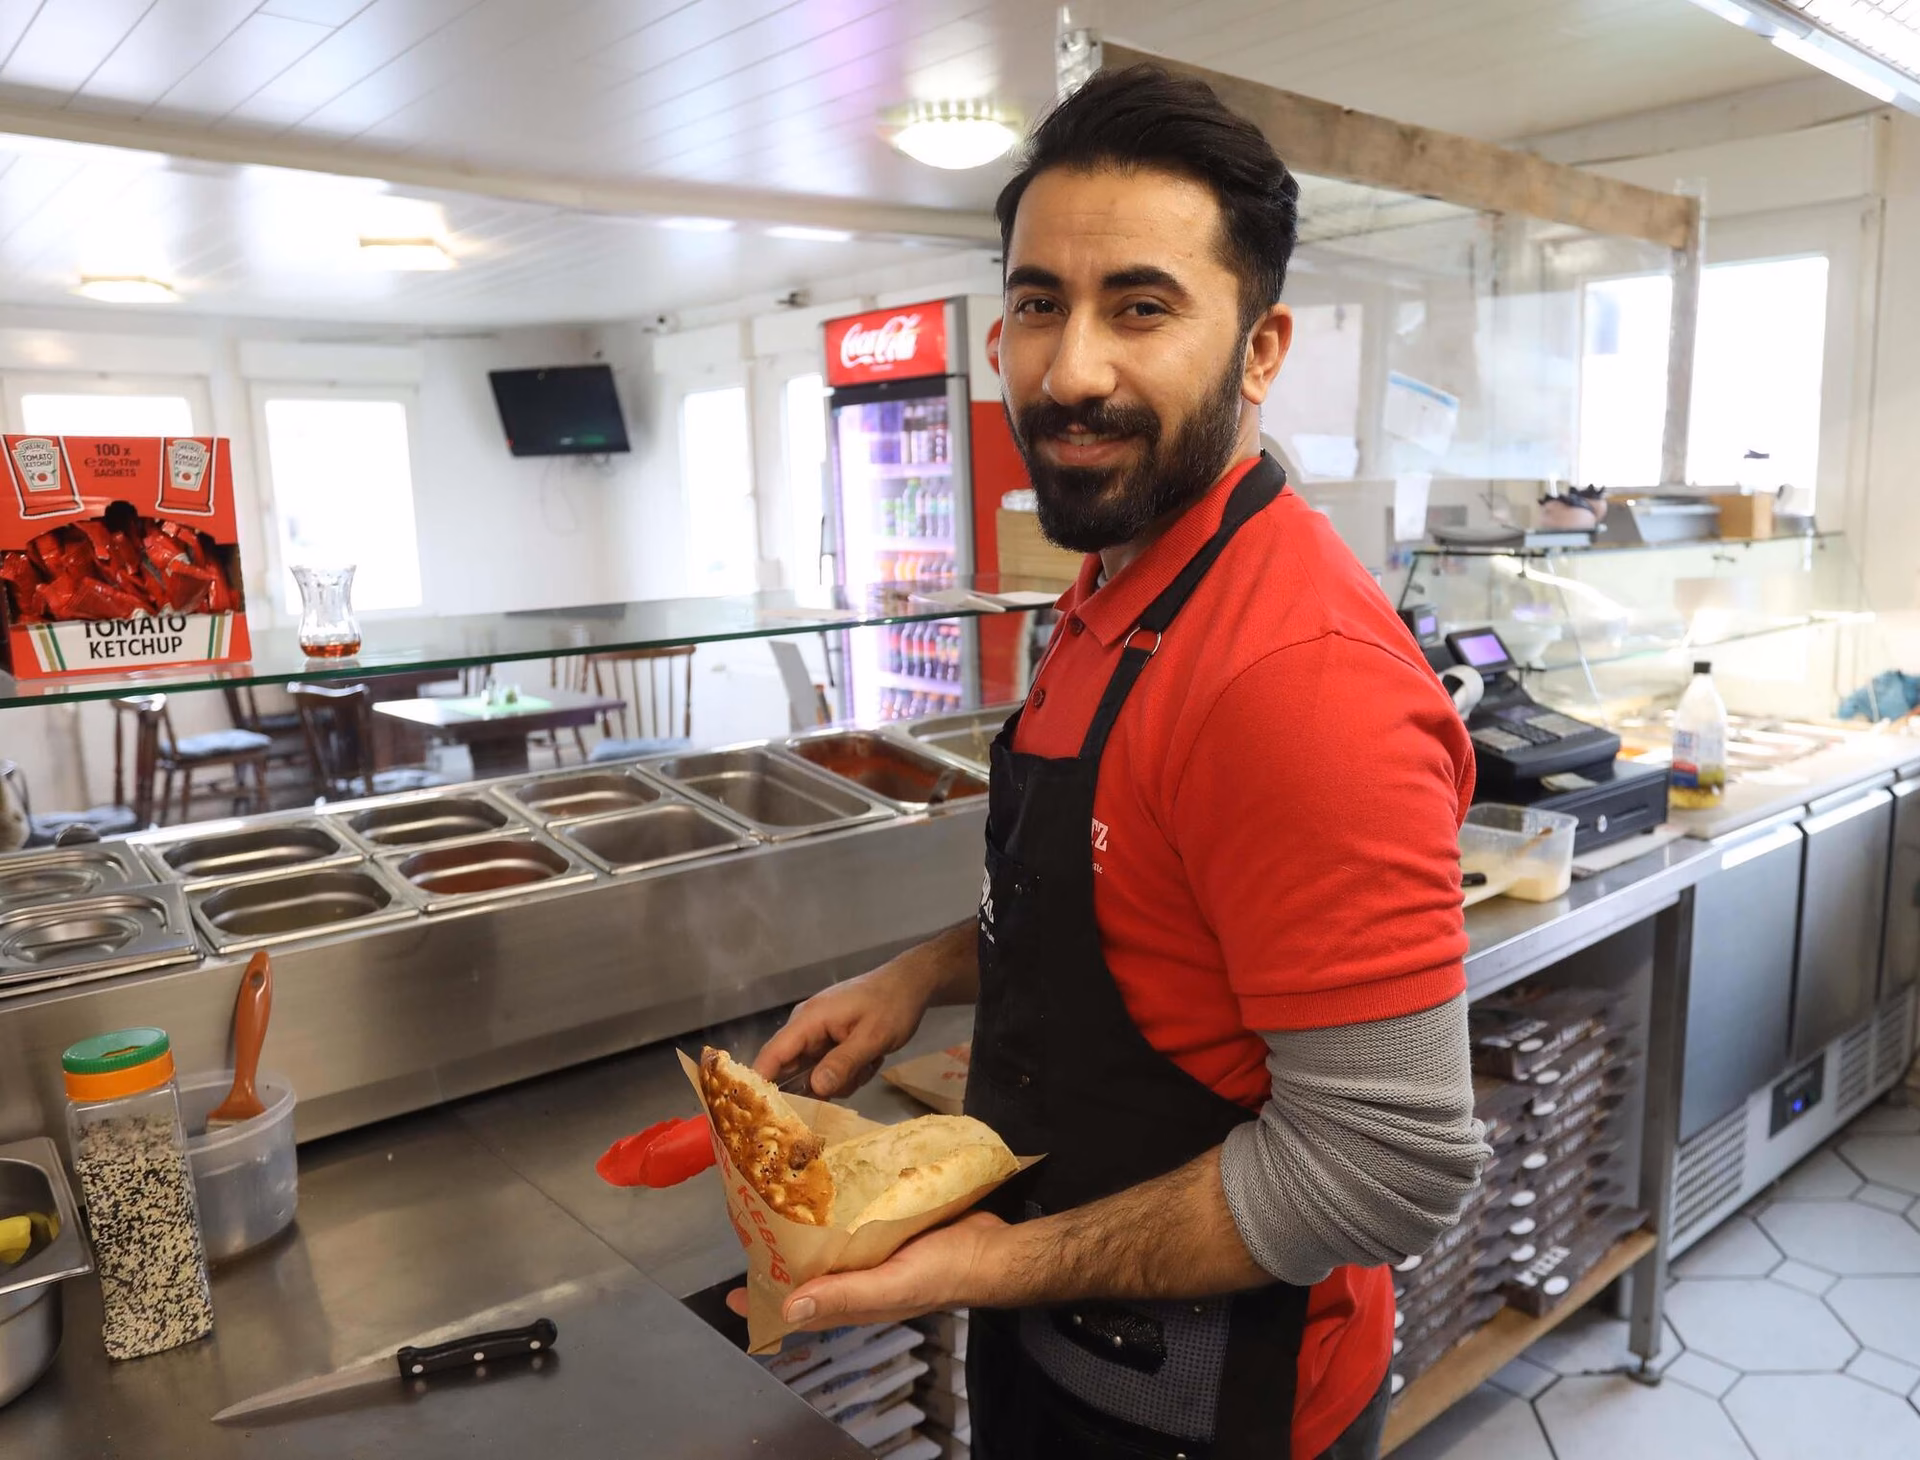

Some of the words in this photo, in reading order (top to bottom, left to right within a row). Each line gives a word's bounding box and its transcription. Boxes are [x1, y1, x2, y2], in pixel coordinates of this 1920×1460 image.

[22, 452, 53, 462] TOMATO
[94, 443, 121, 457] 100
[24, 460, 53, 468] KETCHUP
[94, 468, 137, 478] SACHETS
[84, 616, 187, 638] TOMATO
[89, 636, 183, 659] KETCHUP
[737, 1185, 791, 1285] KEBAB
